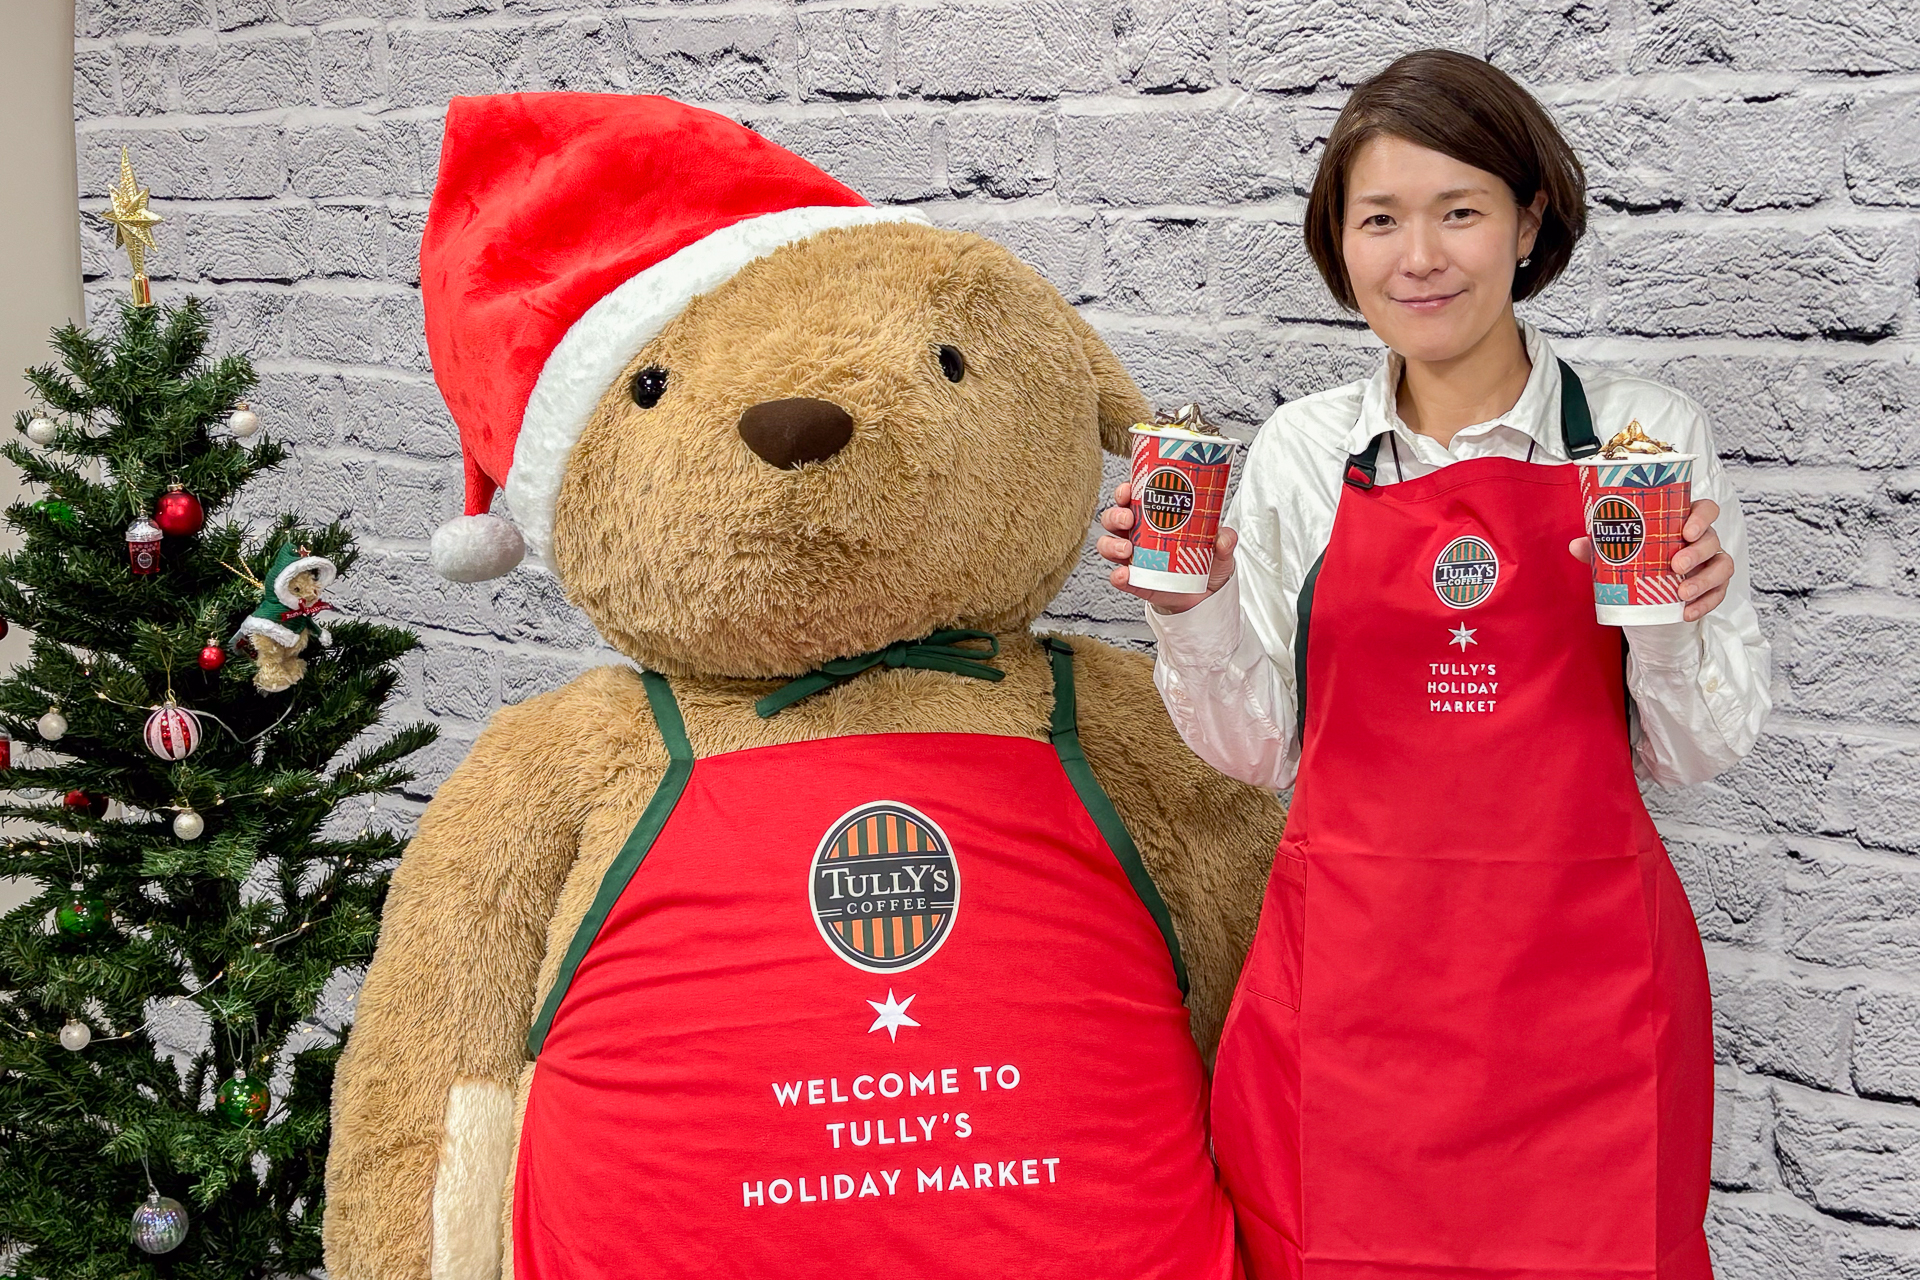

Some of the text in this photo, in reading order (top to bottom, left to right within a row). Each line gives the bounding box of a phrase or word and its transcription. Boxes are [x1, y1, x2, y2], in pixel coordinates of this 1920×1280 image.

[1146, 490, 1191, 507] TULLY'S
[1151, 504, 1181, 513] COFFEE
[1594, 522, 1641, 535] TULLY'S
[1439, 564, 1494, 580] TULLY'S
[1447, 577, 1483, 586] COFFEE
[1429, 663, 1496, 676] TULLY'S
[1427, 682, 1498, 694] HOLIDAY
[1430, 700, 1496, 712] MARKET
[821, 863, 950, 900] TULLY'S
[846, 897, 927, 915] COFFEE
[772, 1064, 1021, 1107] WELCOME TO
[826, 1112, 972, 1148] TULLY'S
[742, 1157, 1060, 1207] HOLIDAY MARKET
